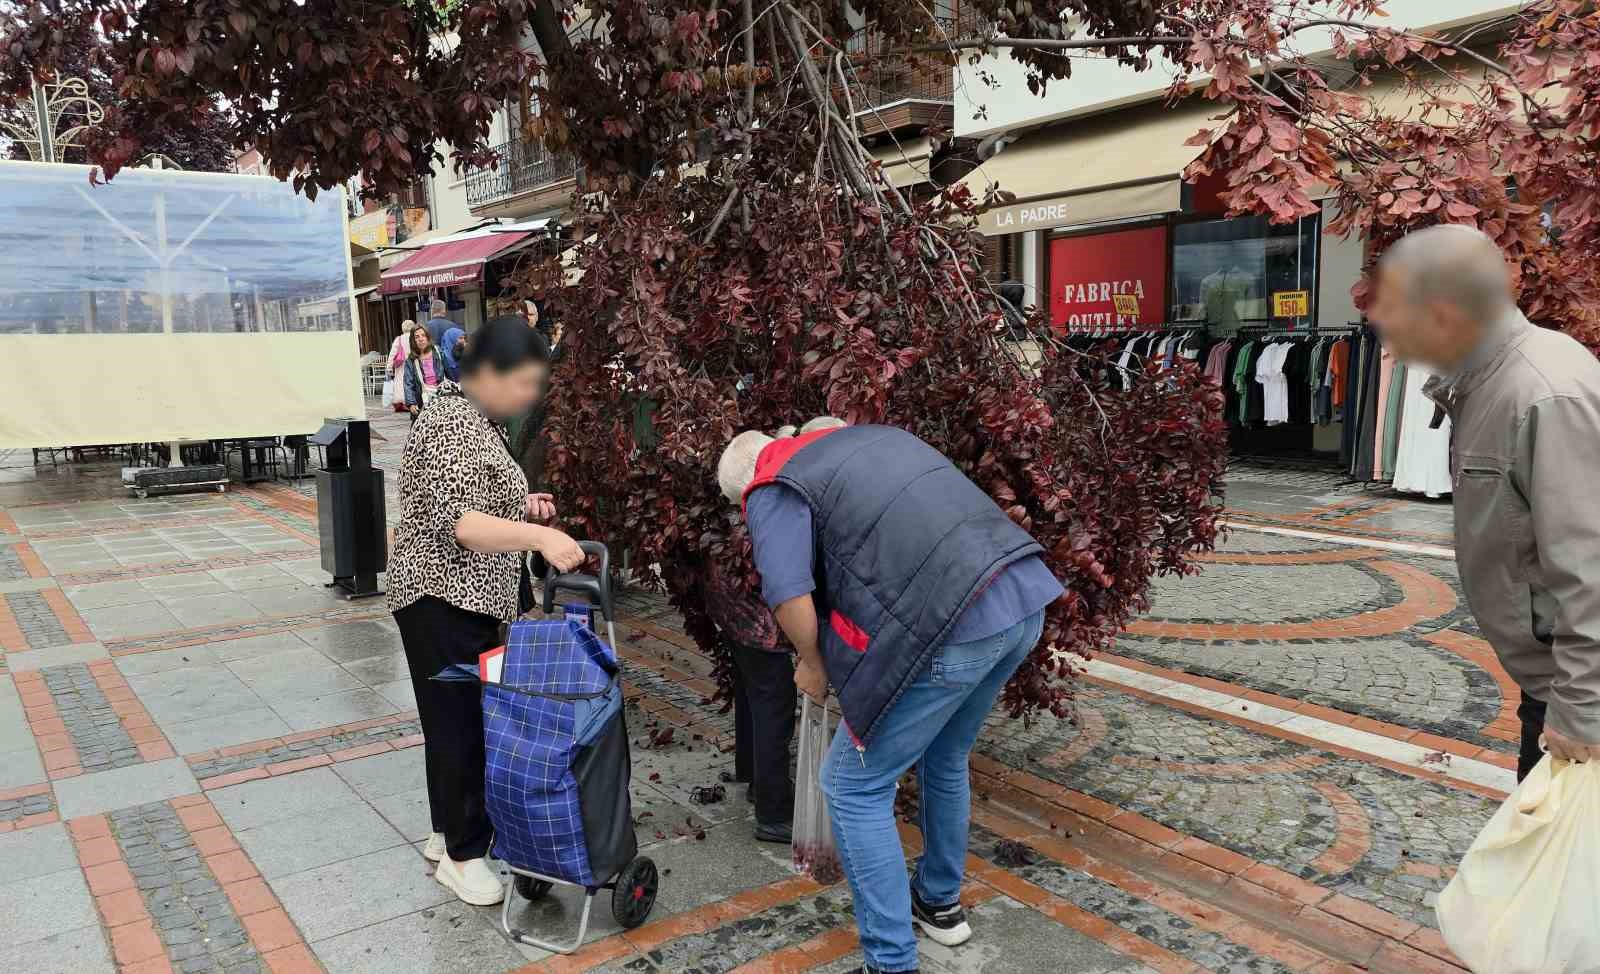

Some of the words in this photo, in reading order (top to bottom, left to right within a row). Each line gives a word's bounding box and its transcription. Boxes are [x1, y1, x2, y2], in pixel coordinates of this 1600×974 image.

[996, 208, 1014, 226] LA
[1020, 203, 1067, 224] PADRE
[1065, 279, 1144, 304] FABRICA
[1280, 300, 1297, 315] 150
